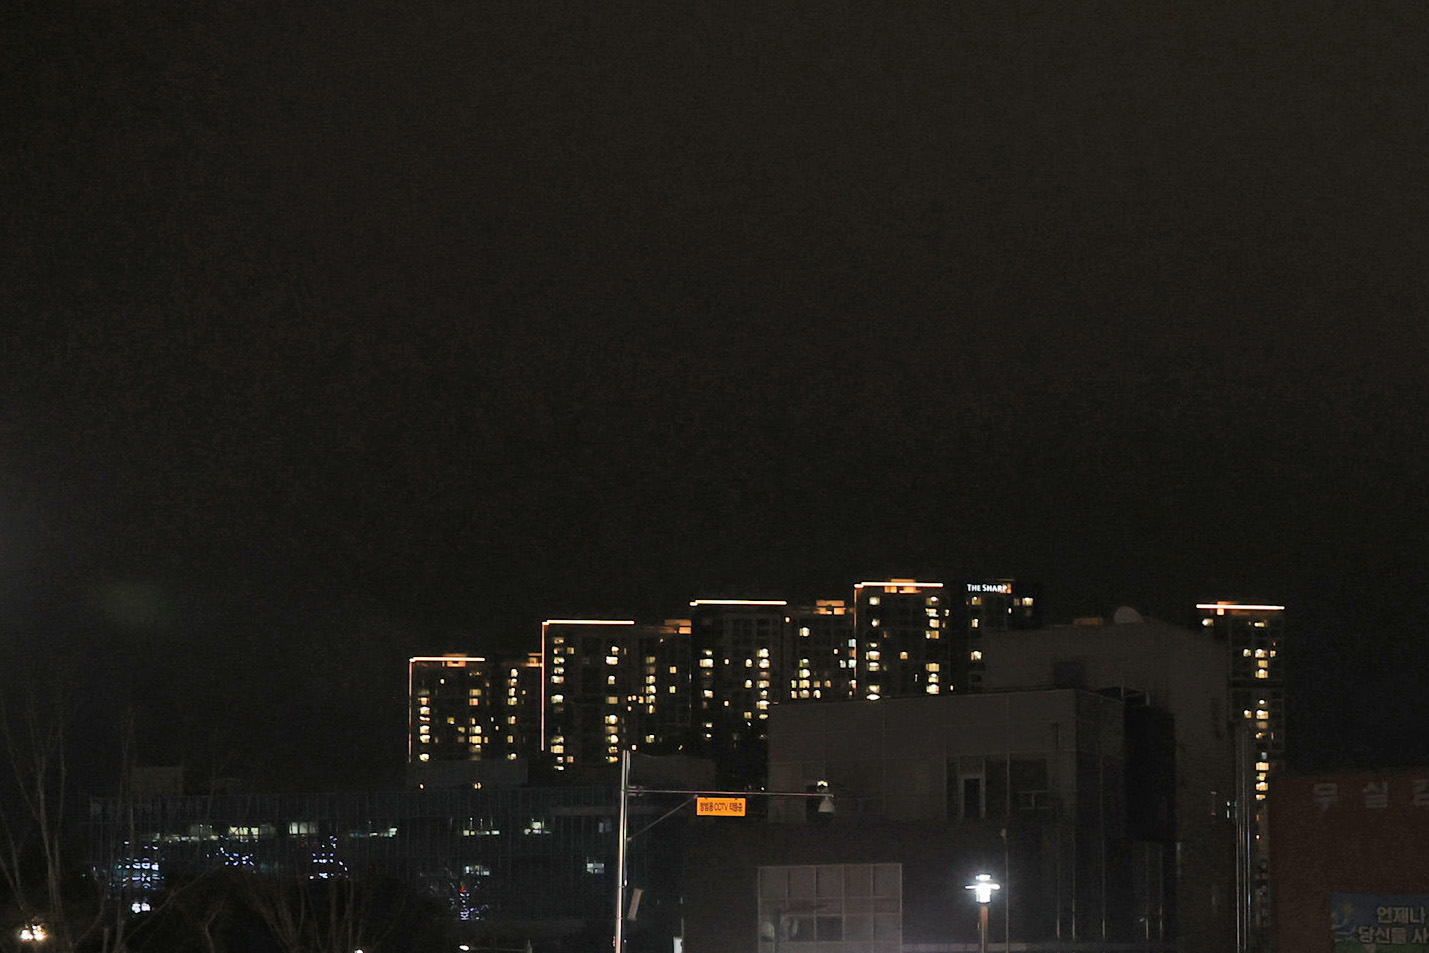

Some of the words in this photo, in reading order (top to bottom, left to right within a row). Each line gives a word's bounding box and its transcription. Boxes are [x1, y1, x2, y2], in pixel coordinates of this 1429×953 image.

[967, 584, 981, 592] THE
[982, 584, 1008, 592] SHARP
[714, 802, 729, 811] CCTV
[1376, 905, 1425, 924] 언제나
[1358, 925, 1407, 944] 당신을
